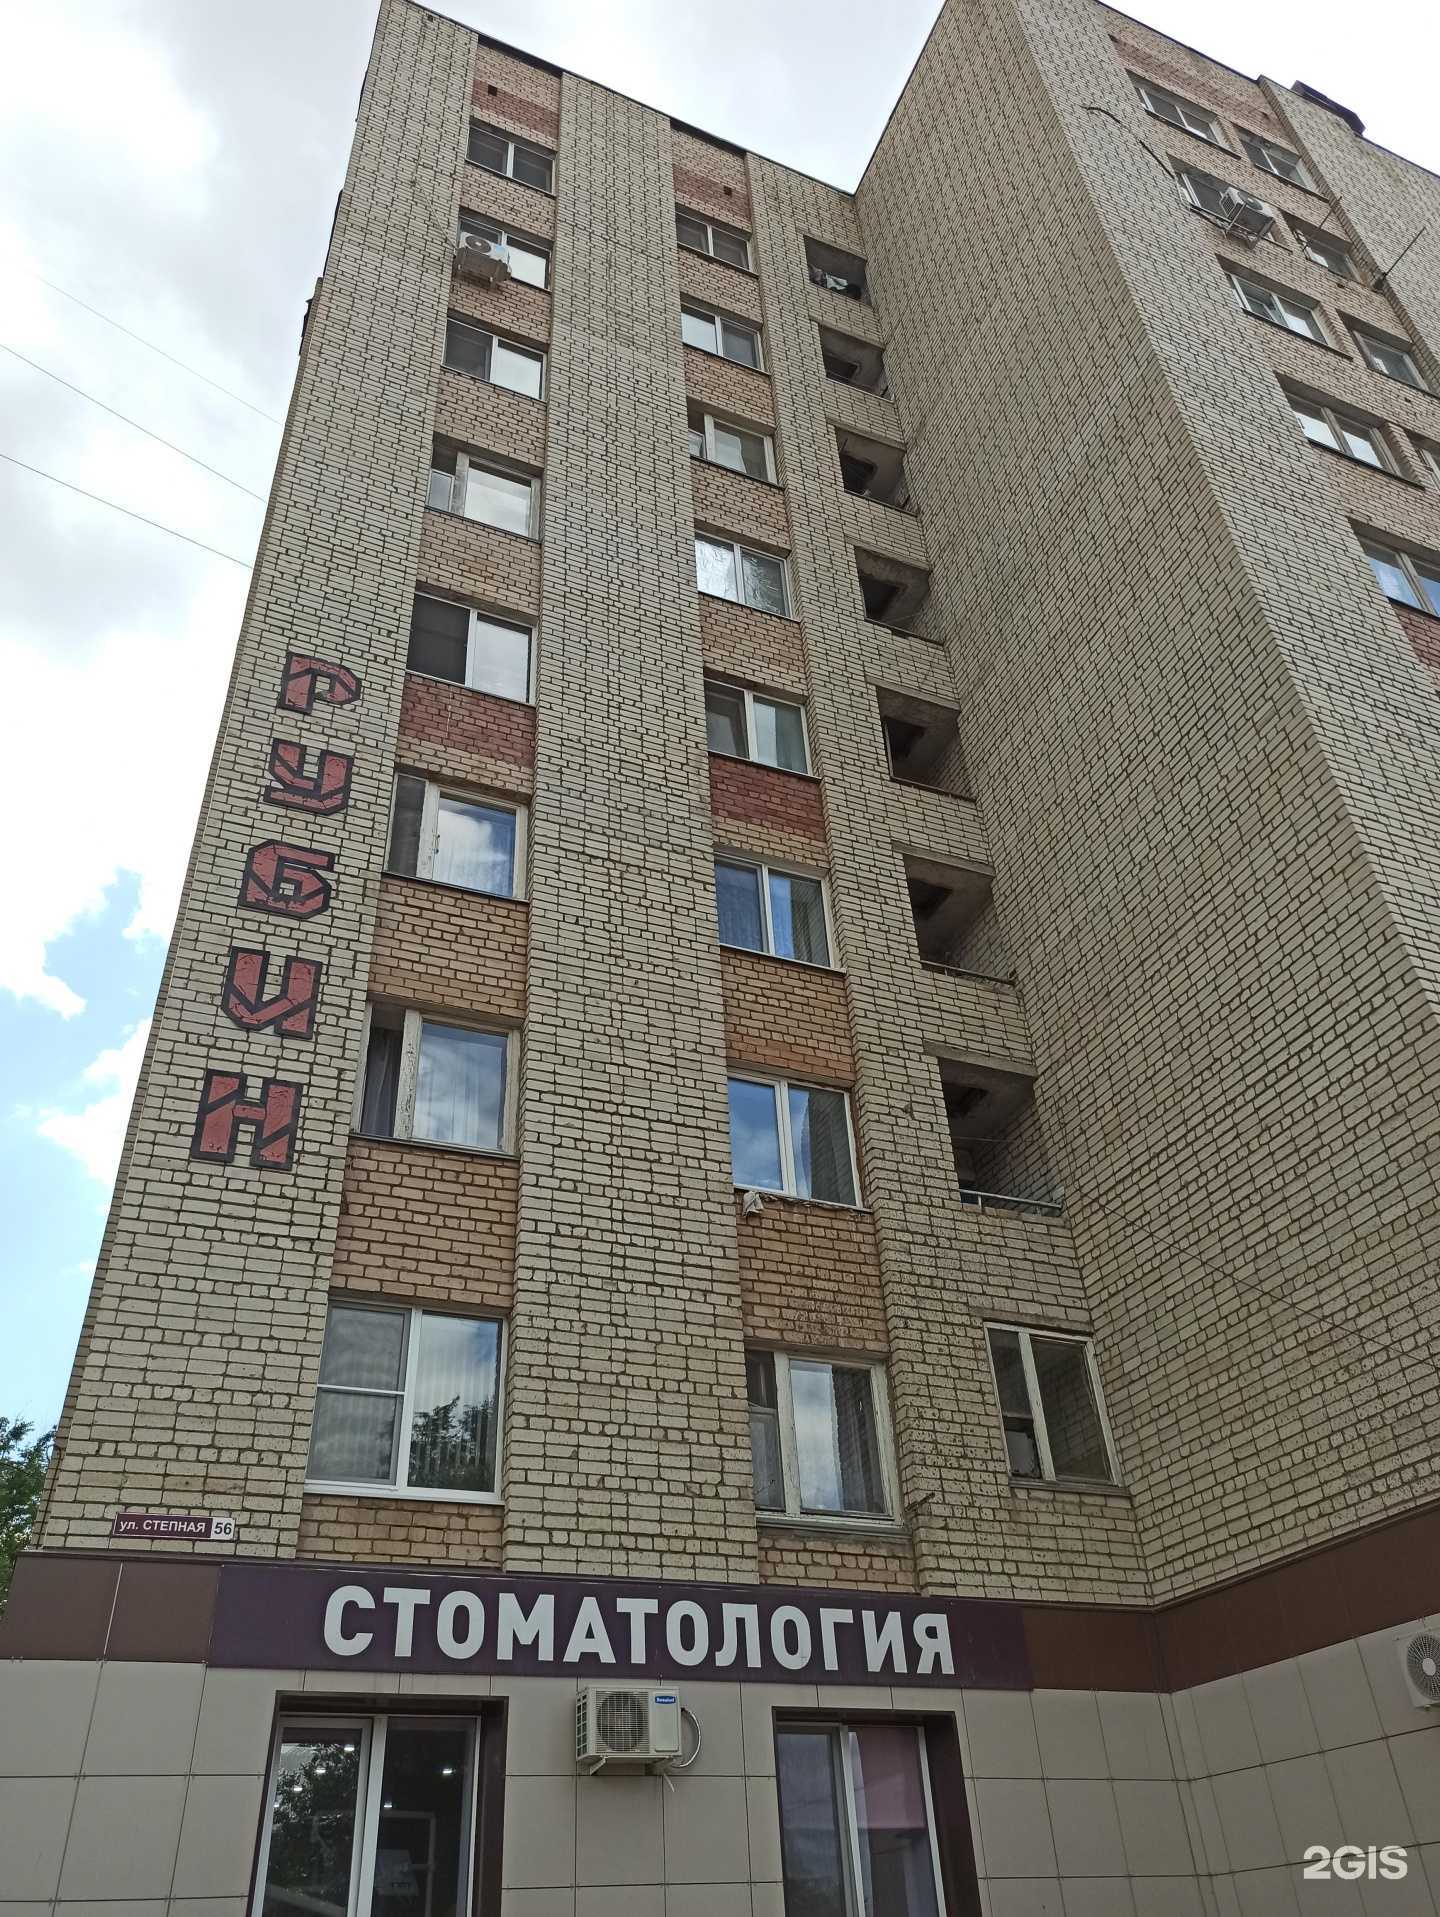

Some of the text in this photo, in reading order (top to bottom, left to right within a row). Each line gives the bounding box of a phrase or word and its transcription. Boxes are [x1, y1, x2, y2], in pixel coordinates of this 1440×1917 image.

[119, 1519, 232, 1535] ул. СТЕПНАЯ 56
[323, 1585, 955, 1677] СТОМАТОЛОГИЯ
